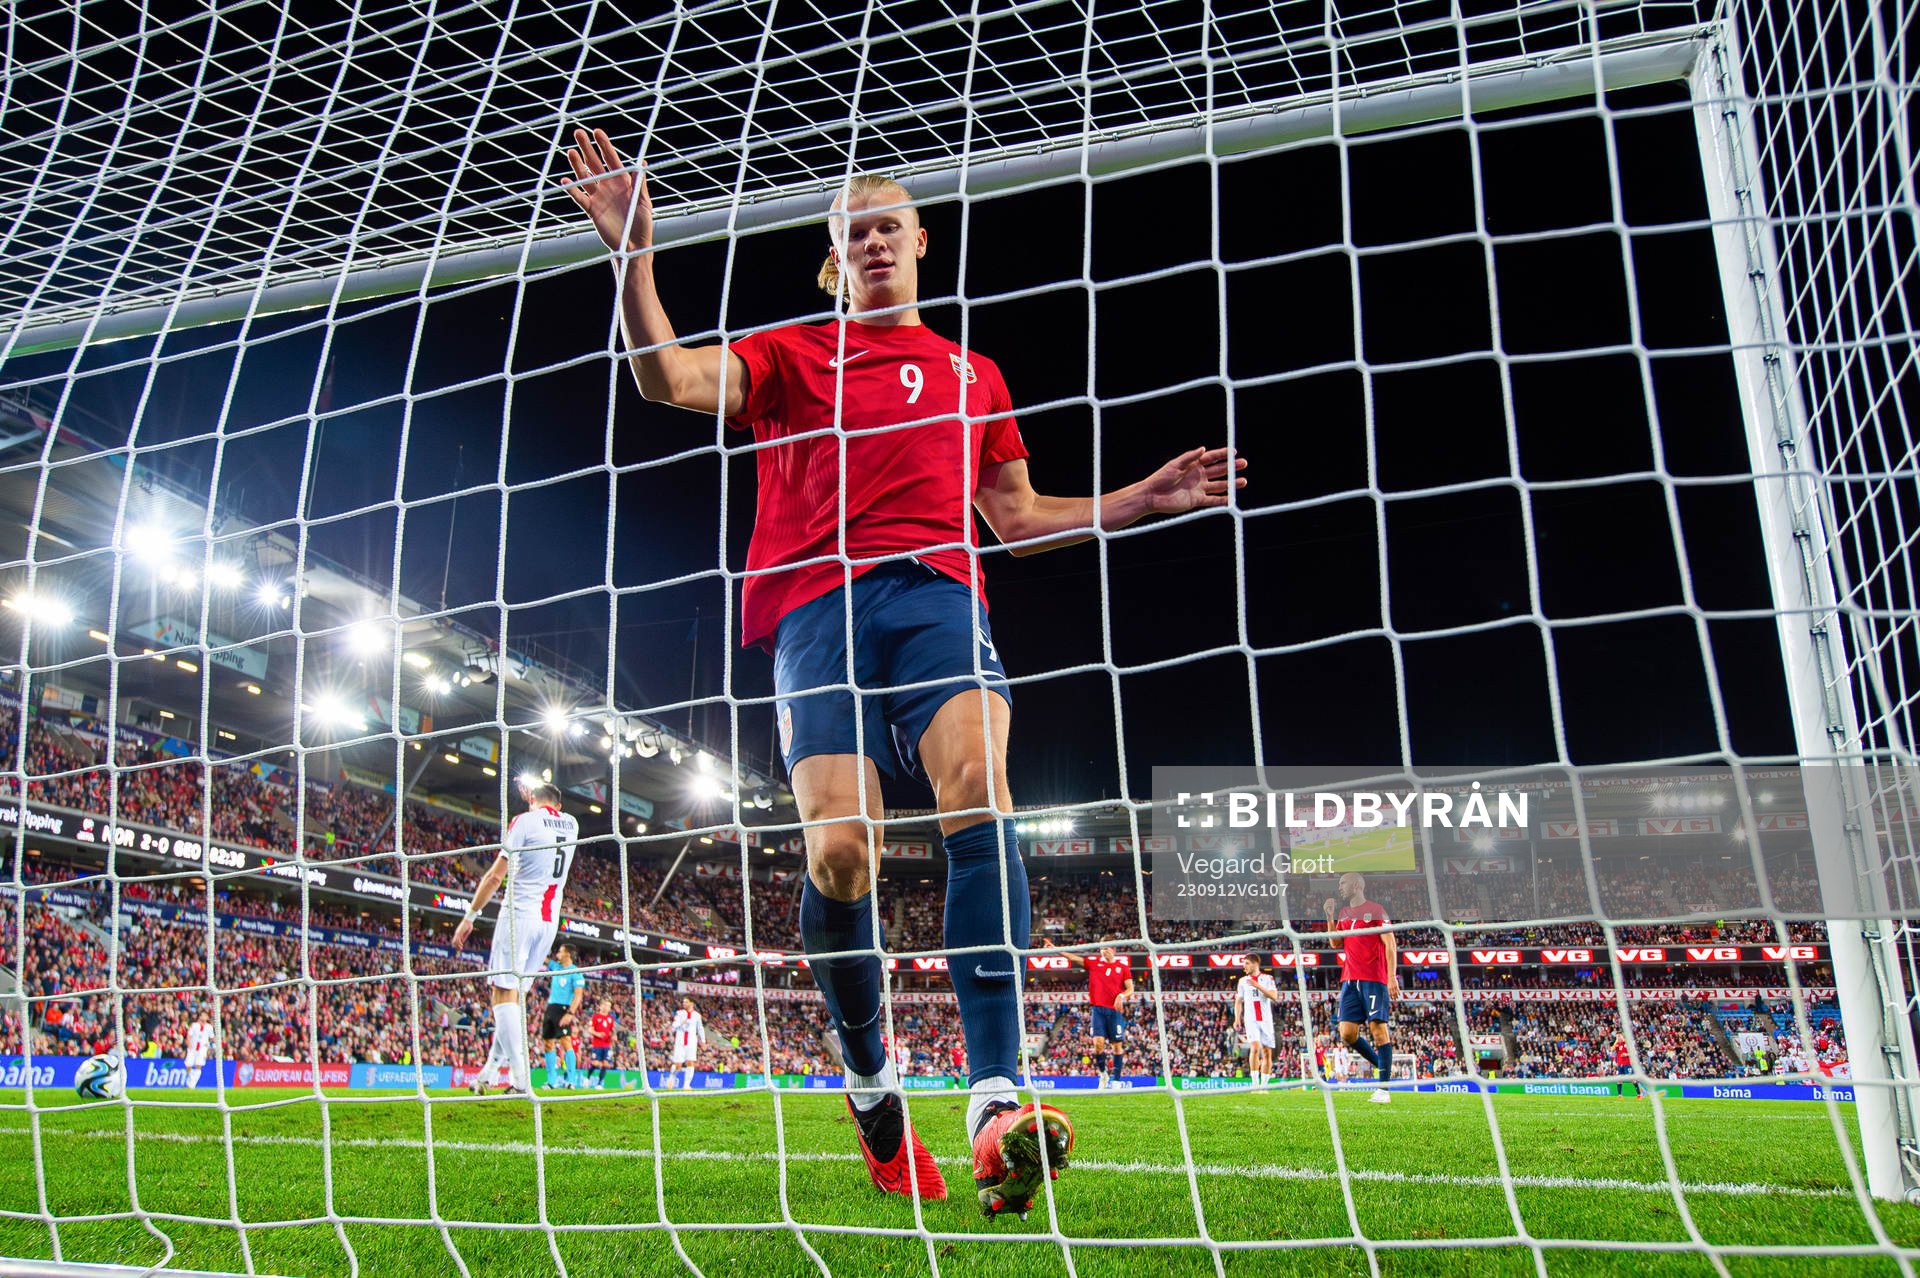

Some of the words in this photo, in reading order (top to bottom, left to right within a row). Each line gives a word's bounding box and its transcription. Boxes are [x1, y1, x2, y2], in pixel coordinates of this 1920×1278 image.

[899, 364, 924, 404] 9
[0, 806, 18, 823] rsk
[1646, 817, 1714, 834] VG
[101, 824, 136, 848] NOR
[1036, 840, 1090, 855] VG
[553, 836, 566, 879] 5
[1447, 857, 1510, 874] VG
[708, 946, 735, 959] VG
[1404, 952, 1449, 964] VG
[1473, 951, 1519, 963] VG
[1542, 950, 1591, 962] VG
[1616, 949, 1663, 961] VG
[1688, 948, 1738, 960] VG
[1763, 947, 1815, 959] VG
[914, 958, 948, 969] VG
[1029, 956, 1069, 968] VG
[1149, 955, 1190, 967] VG
[1210, 954, 1247, 966] VG
[1273, 953, 1317, 965] VG
[919, 993, 946, 1001] VG
[1048, 993, 1077, 1001] VG
[1185, 992, 1214, 1000] VG
[1402, 991, 1435, 1000] VG
[1519, 991, 1551, 999] VG
[1559, 990, 1593, 999] VG
[1641, 990, 1675, 998] VG
[1724, 989, 1760, 998] VG
[1369, 995, 1377, 1009] 7
[1469, 1036, 1501, 1045] VG
[145, 1062, 193, 1086] bam
[254, 1069, 302, 1082] EUROPEAN
[303, 1070, 348, 1083] QULIFIERS
[914, 1078, 945, 1088] banan
[1031, 1079, 1055, 1089] ama
[1181, 1078, 1219, 1090] Bendit
[1221, 1078, 1252, 1089] bana
[1435, 1082, 1469, 1093] bama
[1525, 1083, 1568, 1095] Bendit
[1570, 1084, 1610, 1096] banan
[1713, 1087, 1751, 1098] bama
